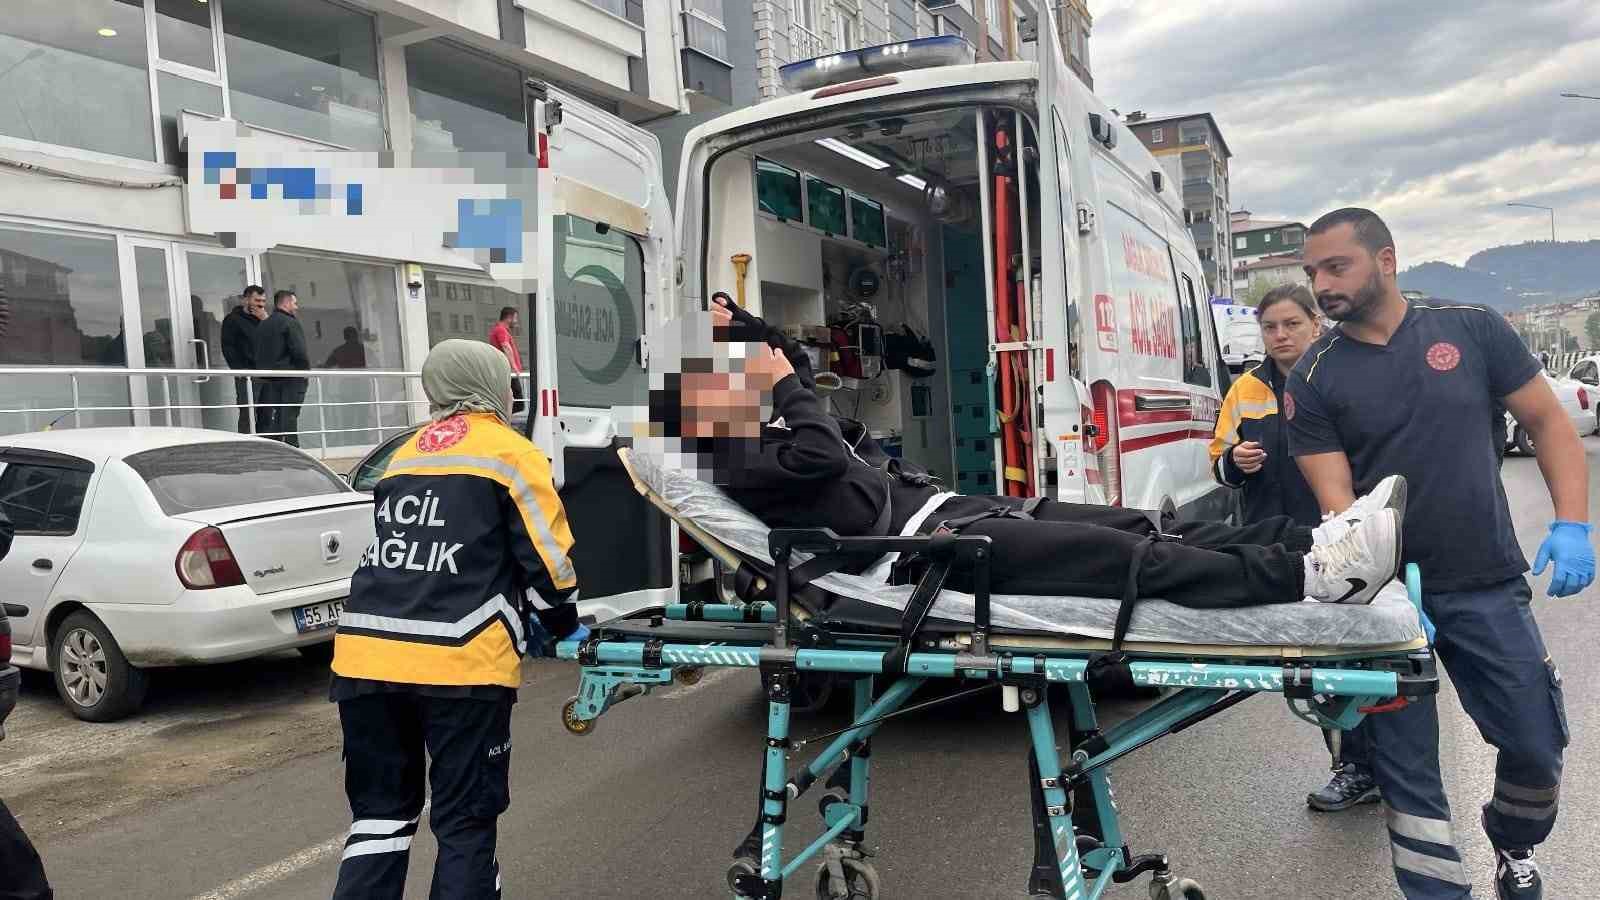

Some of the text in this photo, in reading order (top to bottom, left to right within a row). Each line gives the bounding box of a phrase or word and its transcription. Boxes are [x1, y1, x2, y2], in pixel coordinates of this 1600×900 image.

[377, 489, 446, 527] ACİL
[304, 607, 322, 625] 55
[327, 600, 345, 620] AF
